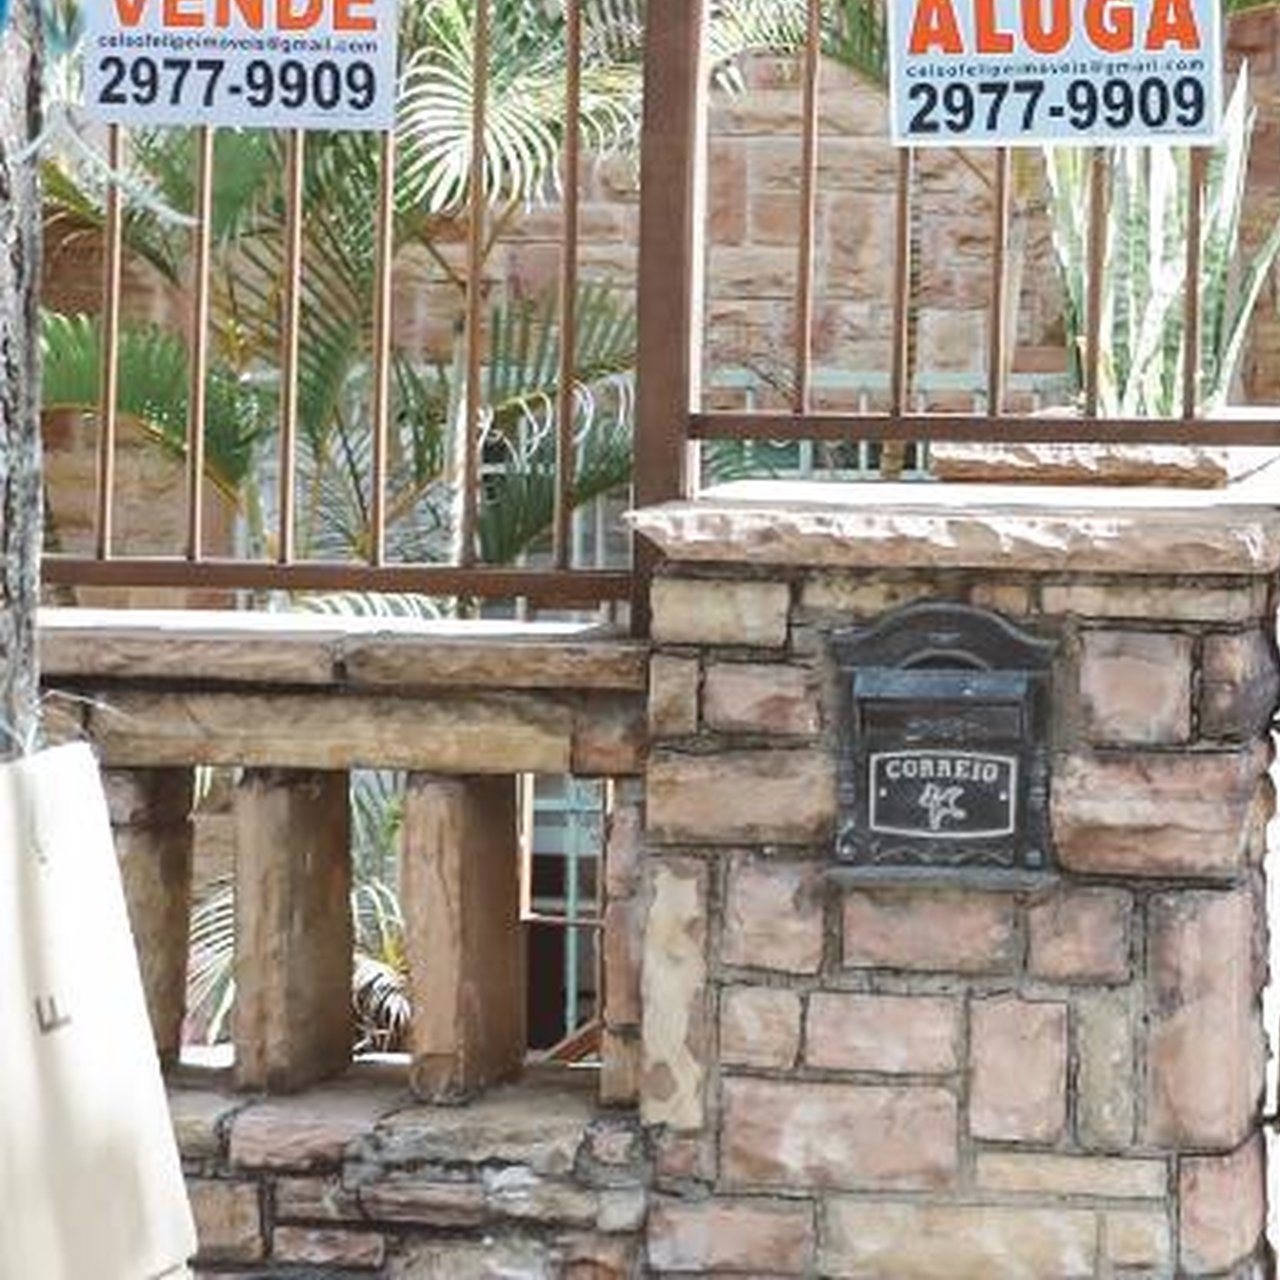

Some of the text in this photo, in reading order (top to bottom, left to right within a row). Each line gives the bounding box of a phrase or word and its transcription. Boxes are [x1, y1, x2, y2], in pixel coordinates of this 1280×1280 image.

[99, 56, 376, 110] 2977-9909
[908, 76, 1206, 133] 2977-9909
[886, 759, 998, 782] CORREIO
